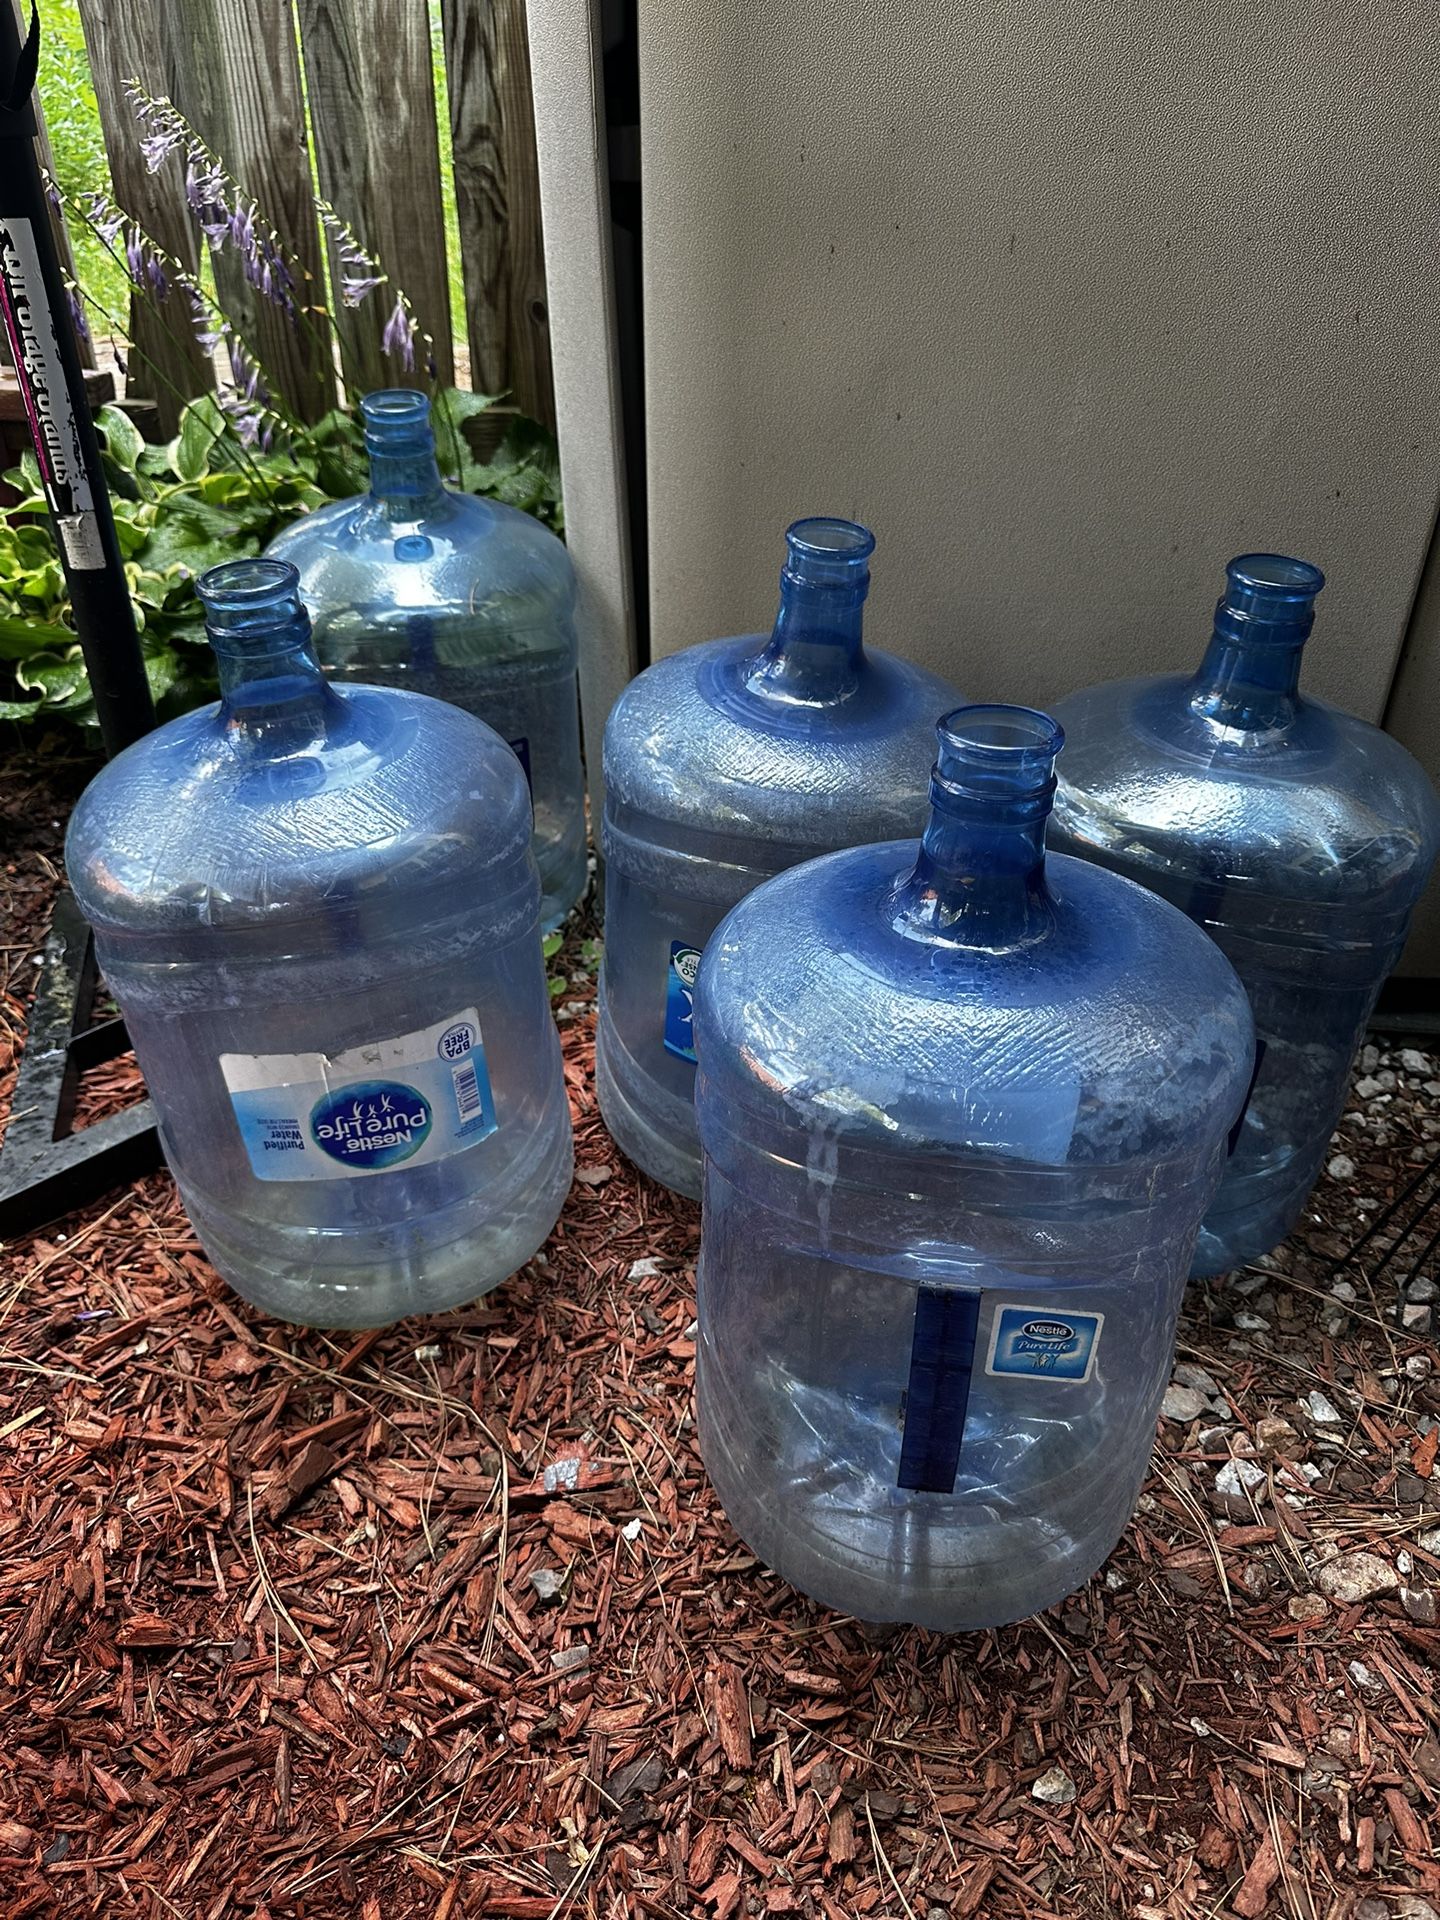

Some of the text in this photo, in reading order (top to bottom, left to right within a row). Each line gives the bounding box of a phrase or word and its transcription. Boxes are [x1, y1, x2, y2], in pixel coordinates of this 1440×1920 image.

[444, 1030, 469, 1050] FREE
[446, 1040, 470, 1058] BPA
[318, 1116, 363, 1141] Life
[366, 1107, 427, 1132] Pure
[271, 1130, 303, 1140] Water
[263, 1140, 306, 1151] Purified
[1018, 1340, 1071, 1351] Pure Life
